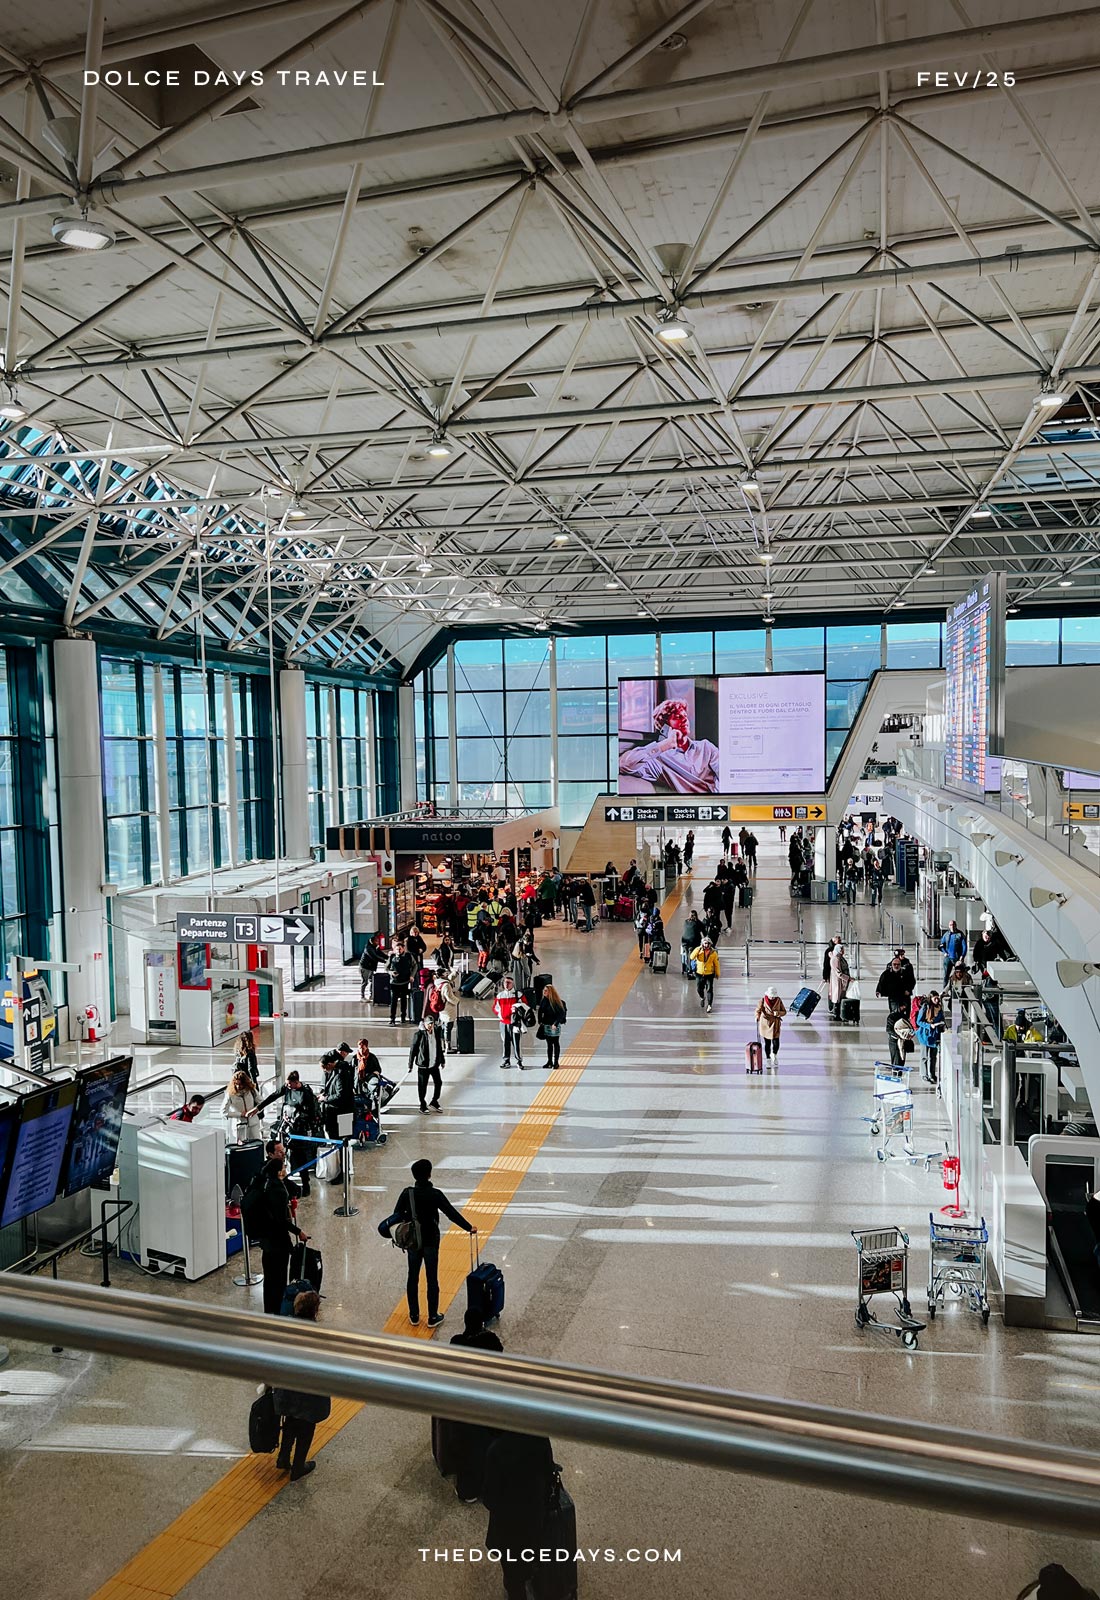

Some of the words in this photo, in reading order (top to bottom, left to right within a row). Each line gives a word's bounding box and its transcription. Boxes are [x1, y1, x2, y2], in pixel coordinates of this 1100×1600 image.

[729, 692, 768, 700] EXCLUSIVE
[422, 832, 462, 842] natoo
[355, 888, 374, 915] 2
[190, 918, 227, 928] Partenze
[180, 928, 228, 939] Departures
[236, 923, 255, 936] T3
[158, 980, 166, 1018] CHANGE
